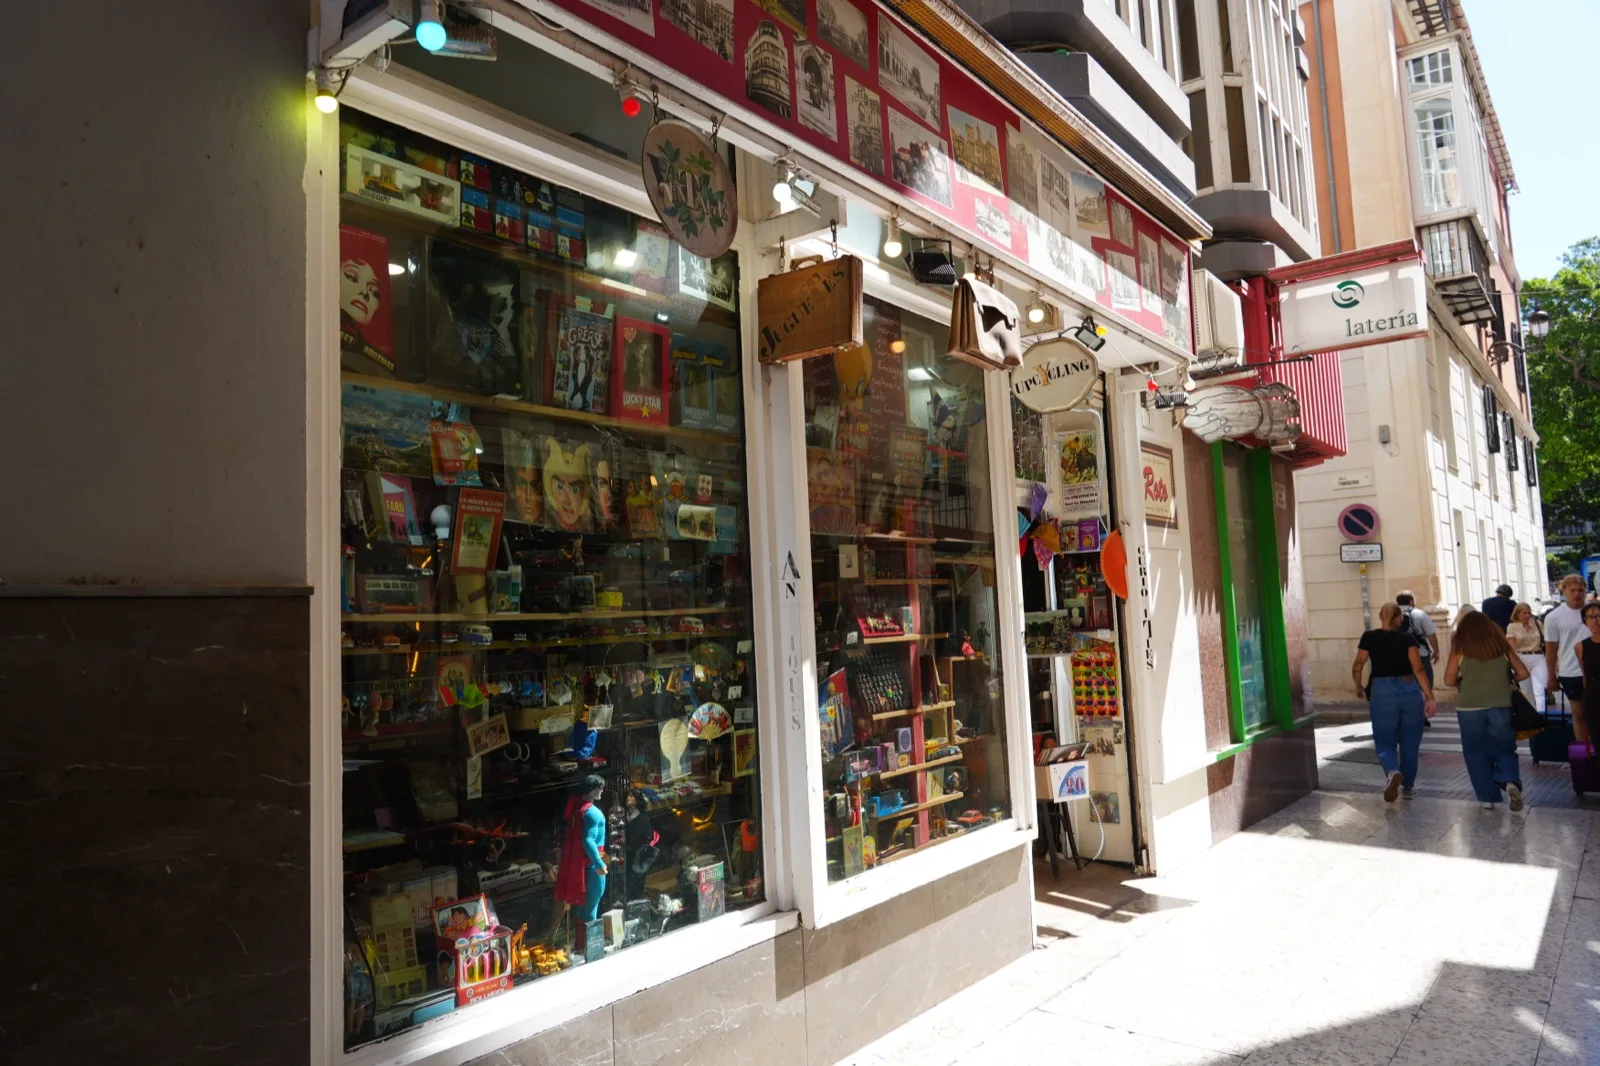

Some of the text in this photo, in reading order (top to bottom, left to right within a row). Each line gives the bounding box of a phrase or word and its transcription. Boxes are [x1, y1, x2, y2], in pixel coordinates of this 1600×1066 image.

[1345, 309, 1418, 337] latería
[567, 326, 605, 349] GREASE
[1015, 359, 1090, 394] UPCYCLING
[623, 391, 662, 411] LUCKY STAR
[385, 499, 404, 513] FARO
